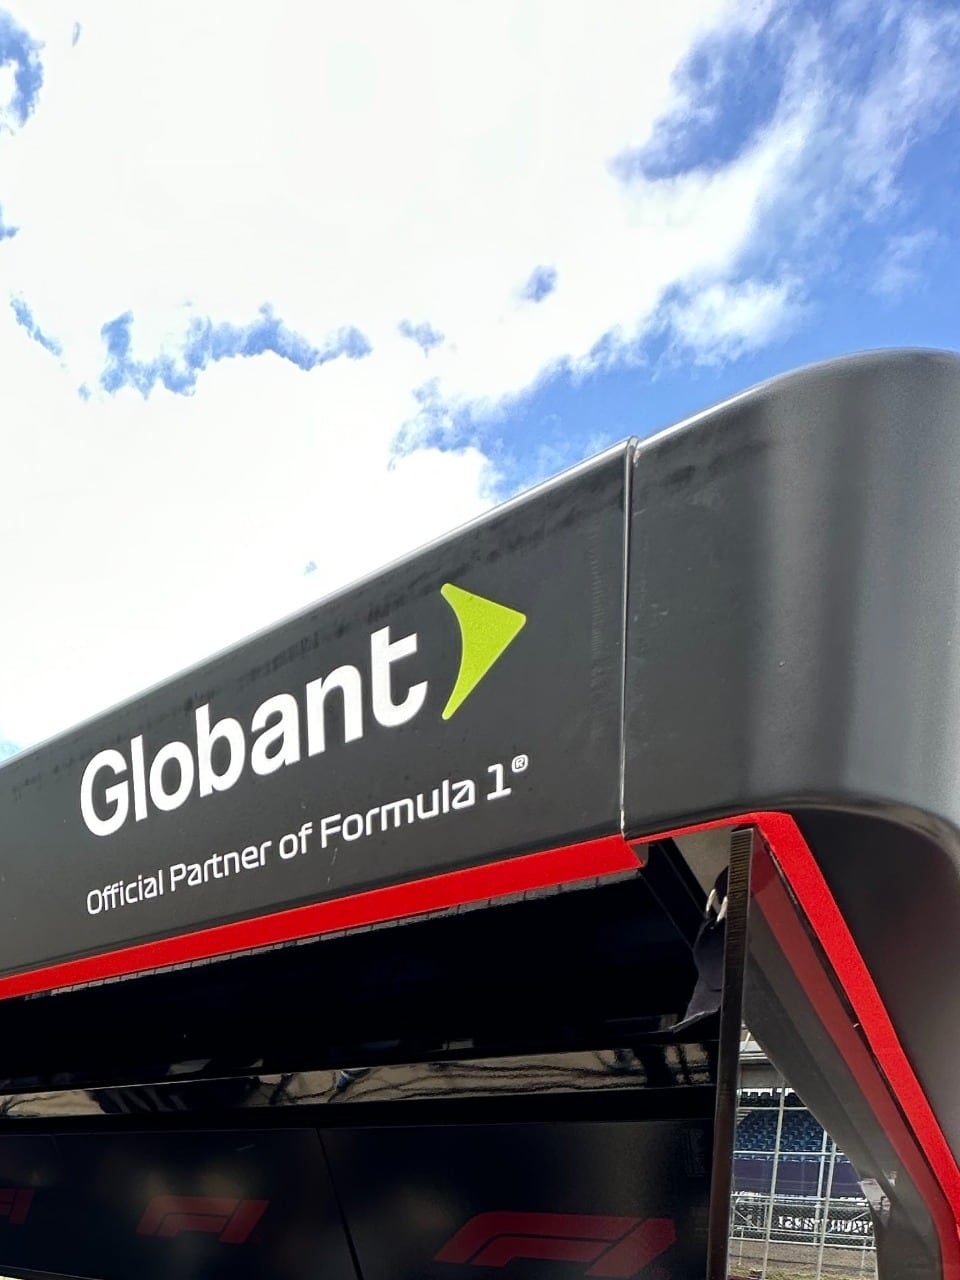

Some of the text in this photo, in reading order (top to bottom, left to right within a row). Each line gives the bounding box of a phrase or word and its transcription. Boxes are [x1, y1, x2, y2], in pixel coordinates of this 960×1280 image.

[80, 625, 428, 836] Globant
[86, 869, 163, 915] Official
[170, 841, 272, 892] Partner
[279, 822, 312, 859] of
[321, 779, 476, 848] Formula
